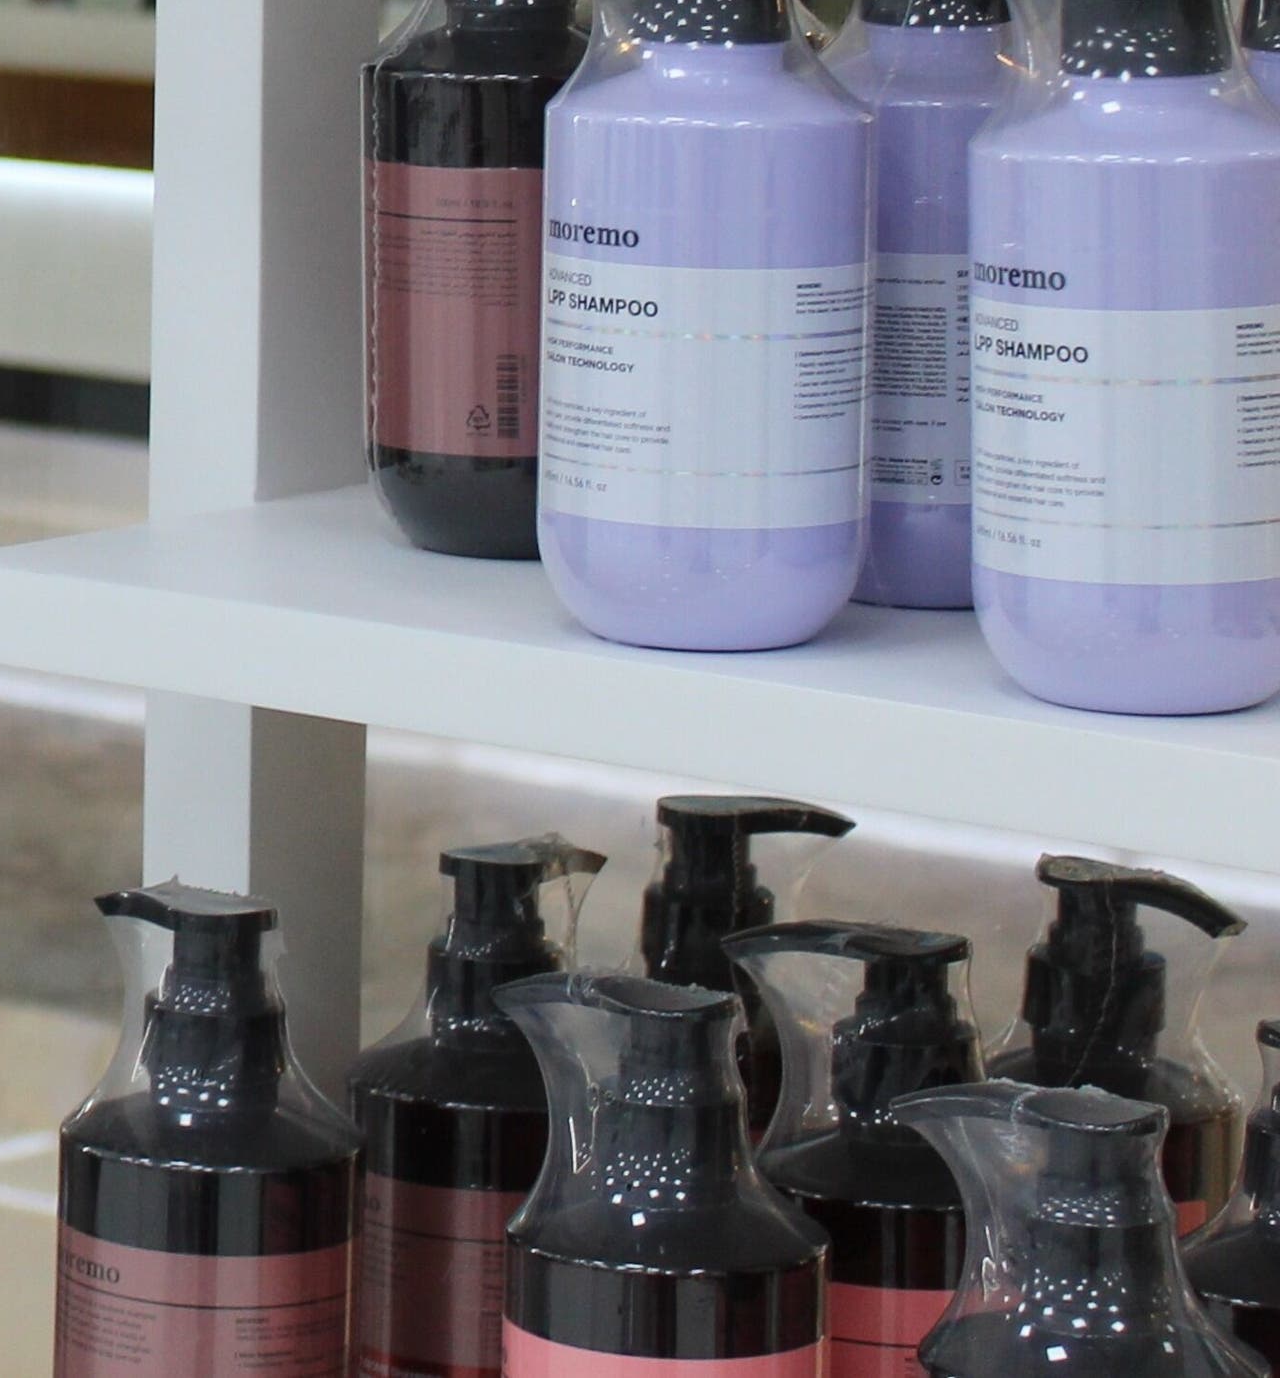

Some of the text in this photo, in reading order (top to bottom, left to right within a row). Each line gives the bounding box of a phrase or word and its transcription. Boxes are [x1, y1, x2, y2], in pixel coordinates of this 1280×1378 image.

[549, 219, 640, 249] moremo
[974, 262, 1067, 291] moremo
[547, 288, 659, 318] LPP SHAMPOO
[567, 356, 635, 373] TECHNOLOGY
[996, 338, 1089, 364] SHAMPOO
[996, 404, 1066, 422] TECHNOLOGY
